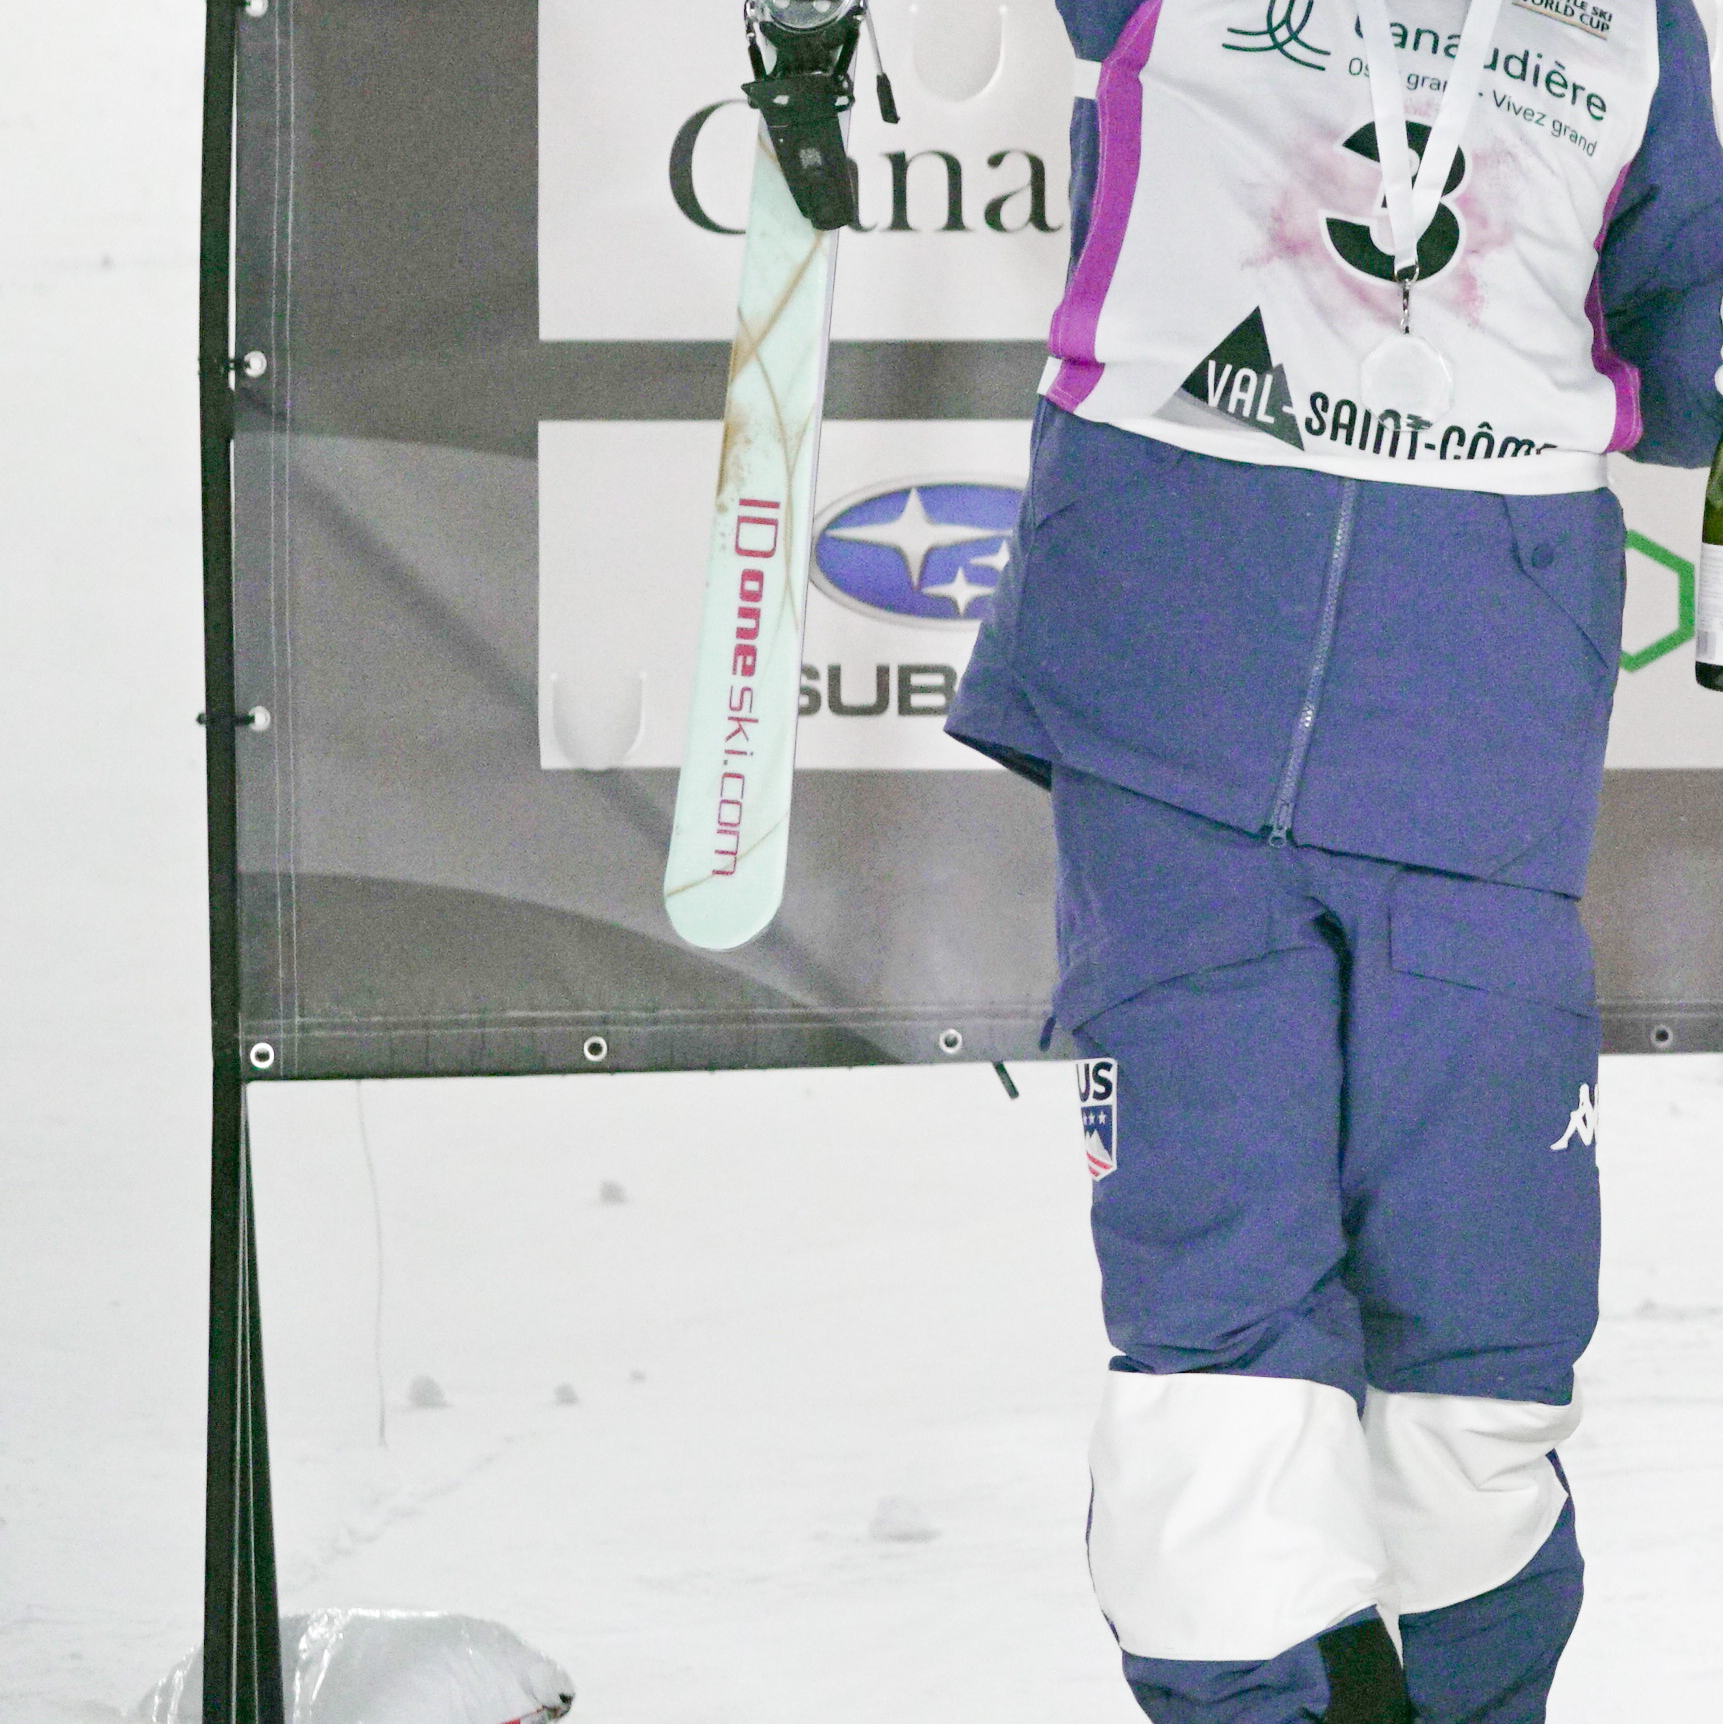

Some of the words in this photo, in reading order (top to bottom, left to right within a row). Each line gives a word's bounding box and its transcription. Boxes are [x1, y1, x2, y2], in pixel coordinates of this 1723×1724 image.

[1579, 11, 1610, 33] CUP
[1592, 5, 1613, 23] SKI
[1493, 90, 1547, 126] Vivez
[1552, 116, 1598, 157] grand
[1325, 120, 1466, 284] 3
[1076, 1061, 1113, 1103] US
